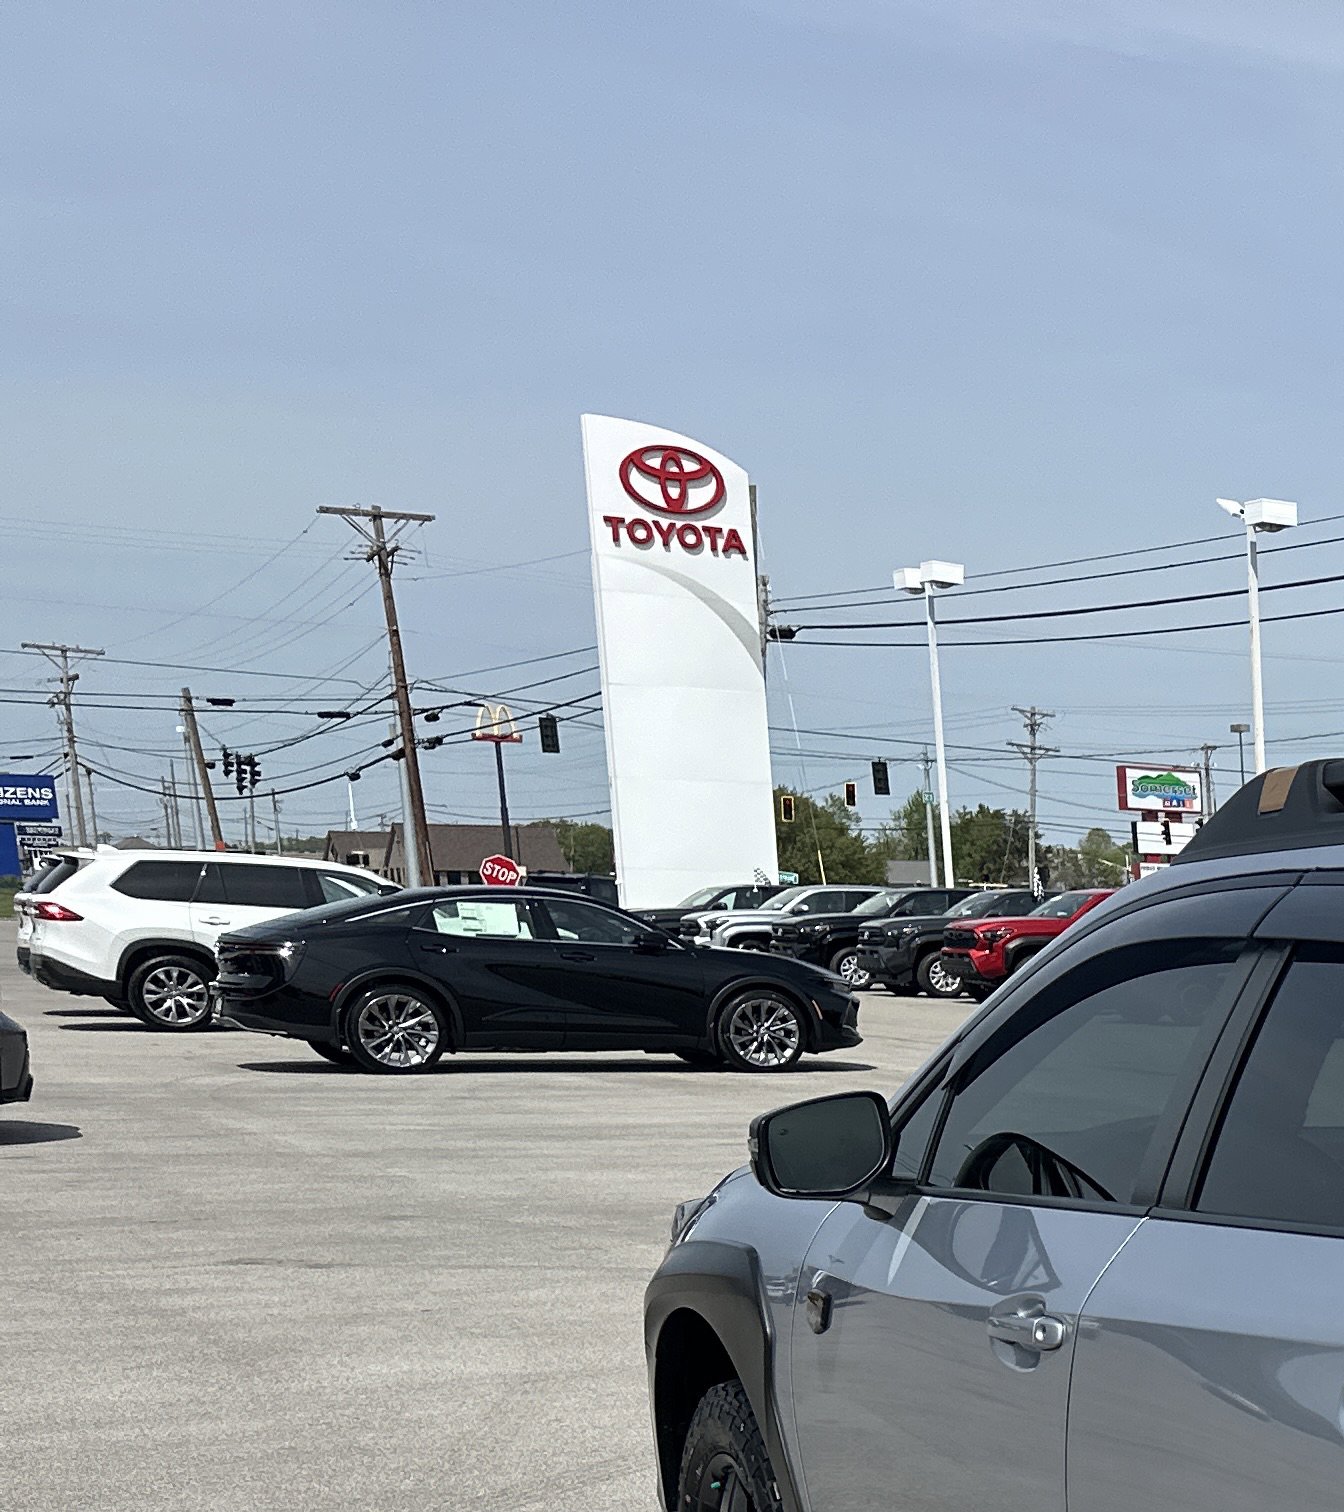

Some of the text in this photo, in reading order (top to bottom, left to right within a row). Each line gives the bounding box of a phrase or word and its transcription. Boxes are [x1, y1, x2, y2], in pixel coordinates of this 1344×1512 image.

[602, 515, 748, 559] TOYOTA
[1131, 780, 1198, 798] Somerset
[483, 862, 517, 883] STOP
